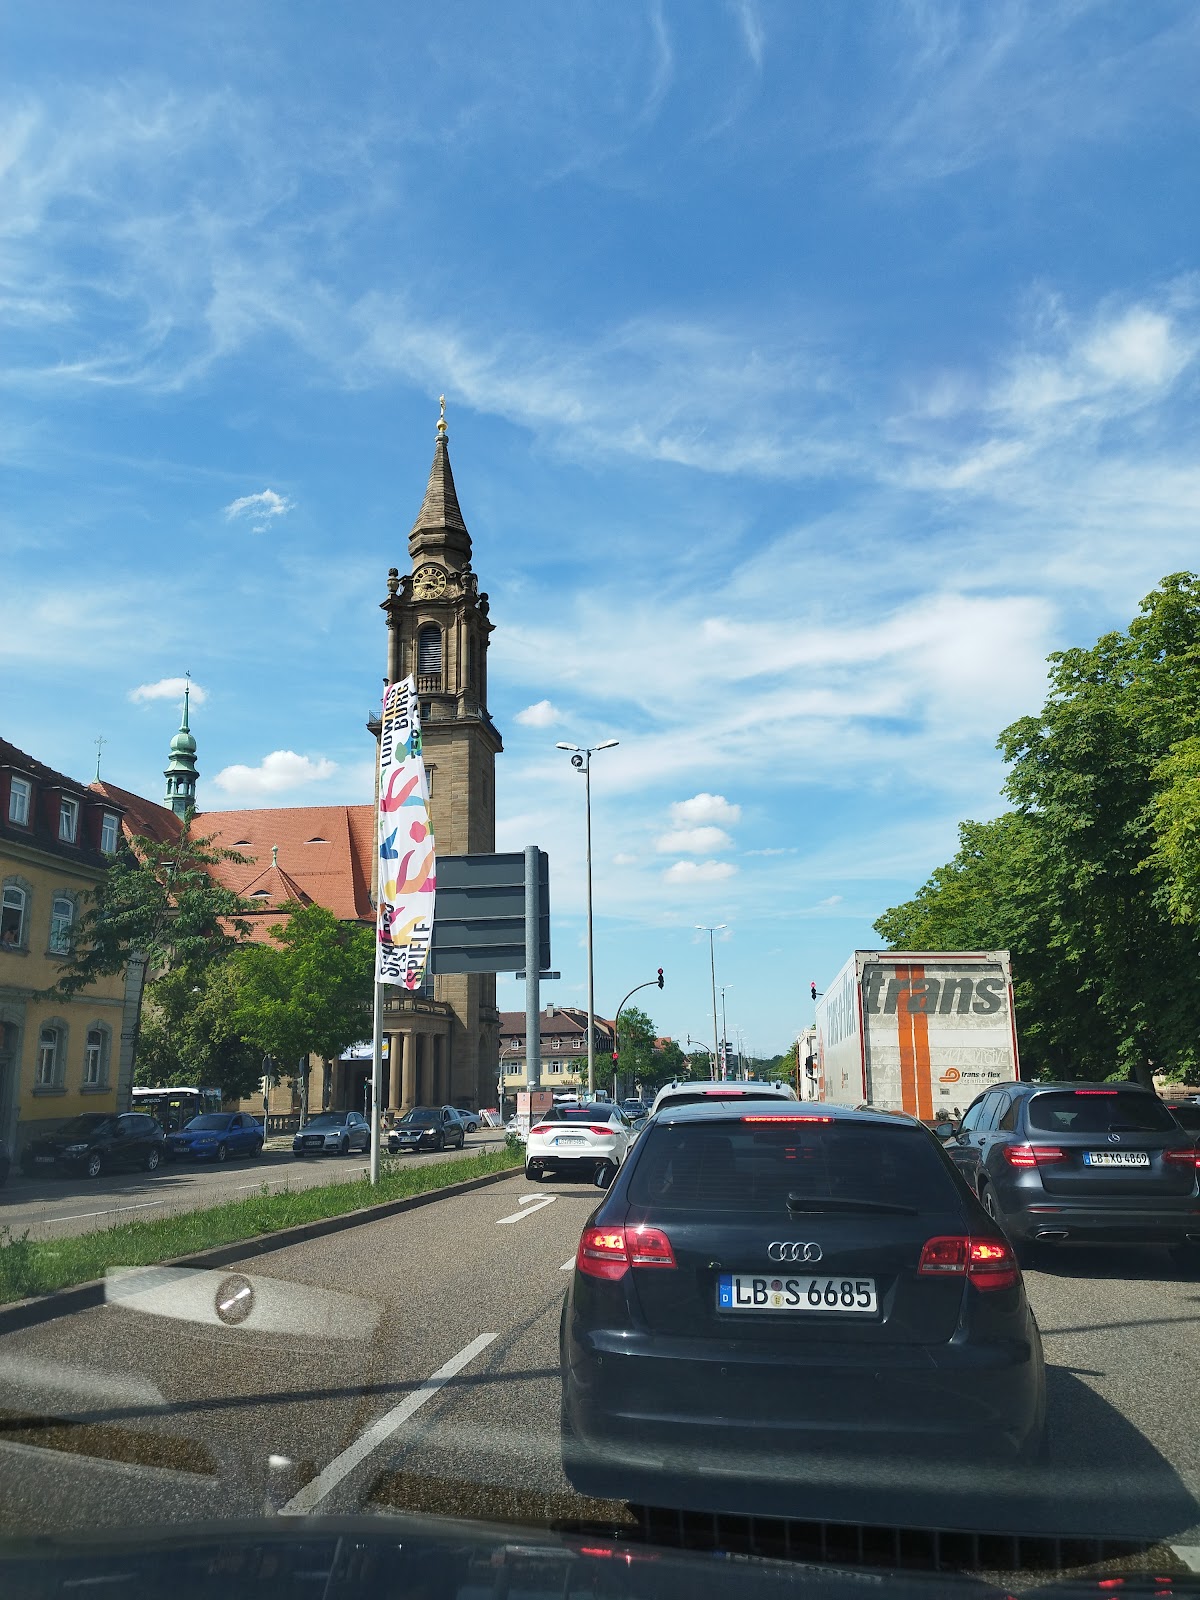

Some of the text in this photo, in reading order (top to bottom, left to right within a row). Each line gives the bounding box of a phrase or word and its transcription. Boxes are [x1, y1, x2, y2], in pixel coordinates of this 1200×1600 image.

[381, 689, 396, 767] LUDWIGS
[394, 683, 409, 732] BURG
[867, 971, 1006, 1015] trans
[1090, 1153, 1103, 1164] LB
[722, 1278, 871, 1308] D LB S 6685
